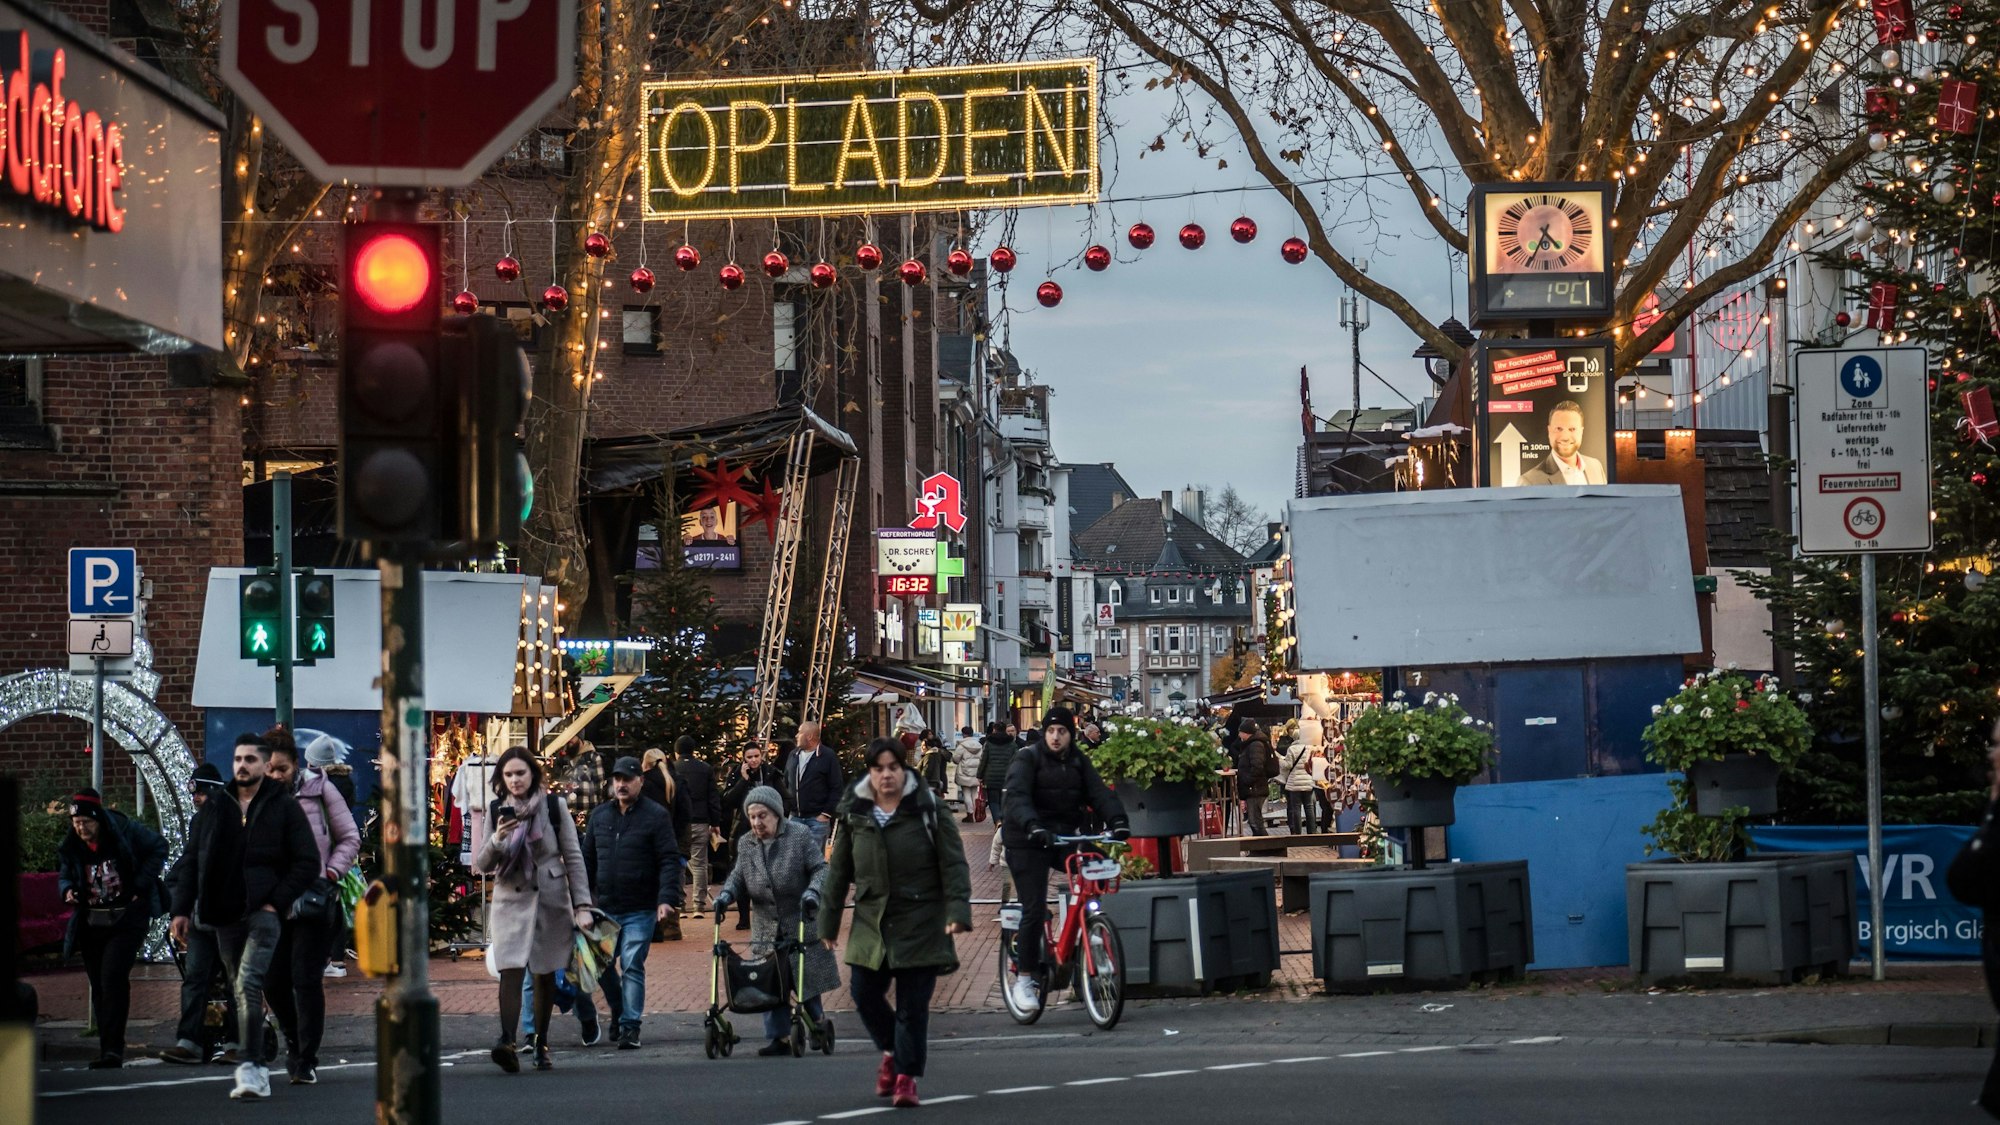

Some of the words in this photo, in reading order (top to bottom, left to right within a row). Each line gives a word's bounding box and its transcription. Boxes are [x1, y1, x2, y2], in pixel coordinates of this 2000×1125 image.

[0, 28, 125, 234] dafone
[660, 83, 1075, 197] OPLADEN
[1508, 354, 1553, 367] Fachgeschäft
[1536, 364, 1563, 374] Internet
[1580, 371, 1604, 379] opladen
[1505, 384, 1518, 392] und
[1520, 378, 1554, 389] Mobilfunk
[1851, 399, 1873, 408] Zone
[1821, 412, 1857, 421] Radfahrer
[1860, 411, 1873, 420] frei
[1836, 423, 1887, 433] Lieferverkehr
[1845, 436, 1879, 446] werktags
[1831, 448, 1836, 458] 6
[1881, 446, 1894, 456] 14h
[1857, 460, 1870, 469] frei
[1823, 478, 1897, 489] Feuerwehrzufahrt
[880, 530, 936, 538] KIEFERORTHOPÄDIE
[694, 553, 714, 561] 02171
[720, 553, 735, 561] 2411
[85, 557, 120, 606] P
[891, 577, 929, 592] 16:32
[1412, 671, 1422, 686] 7
[1857, 854, 1937, 900] VR
[1858, 919, 1948, 945] Brgisch
